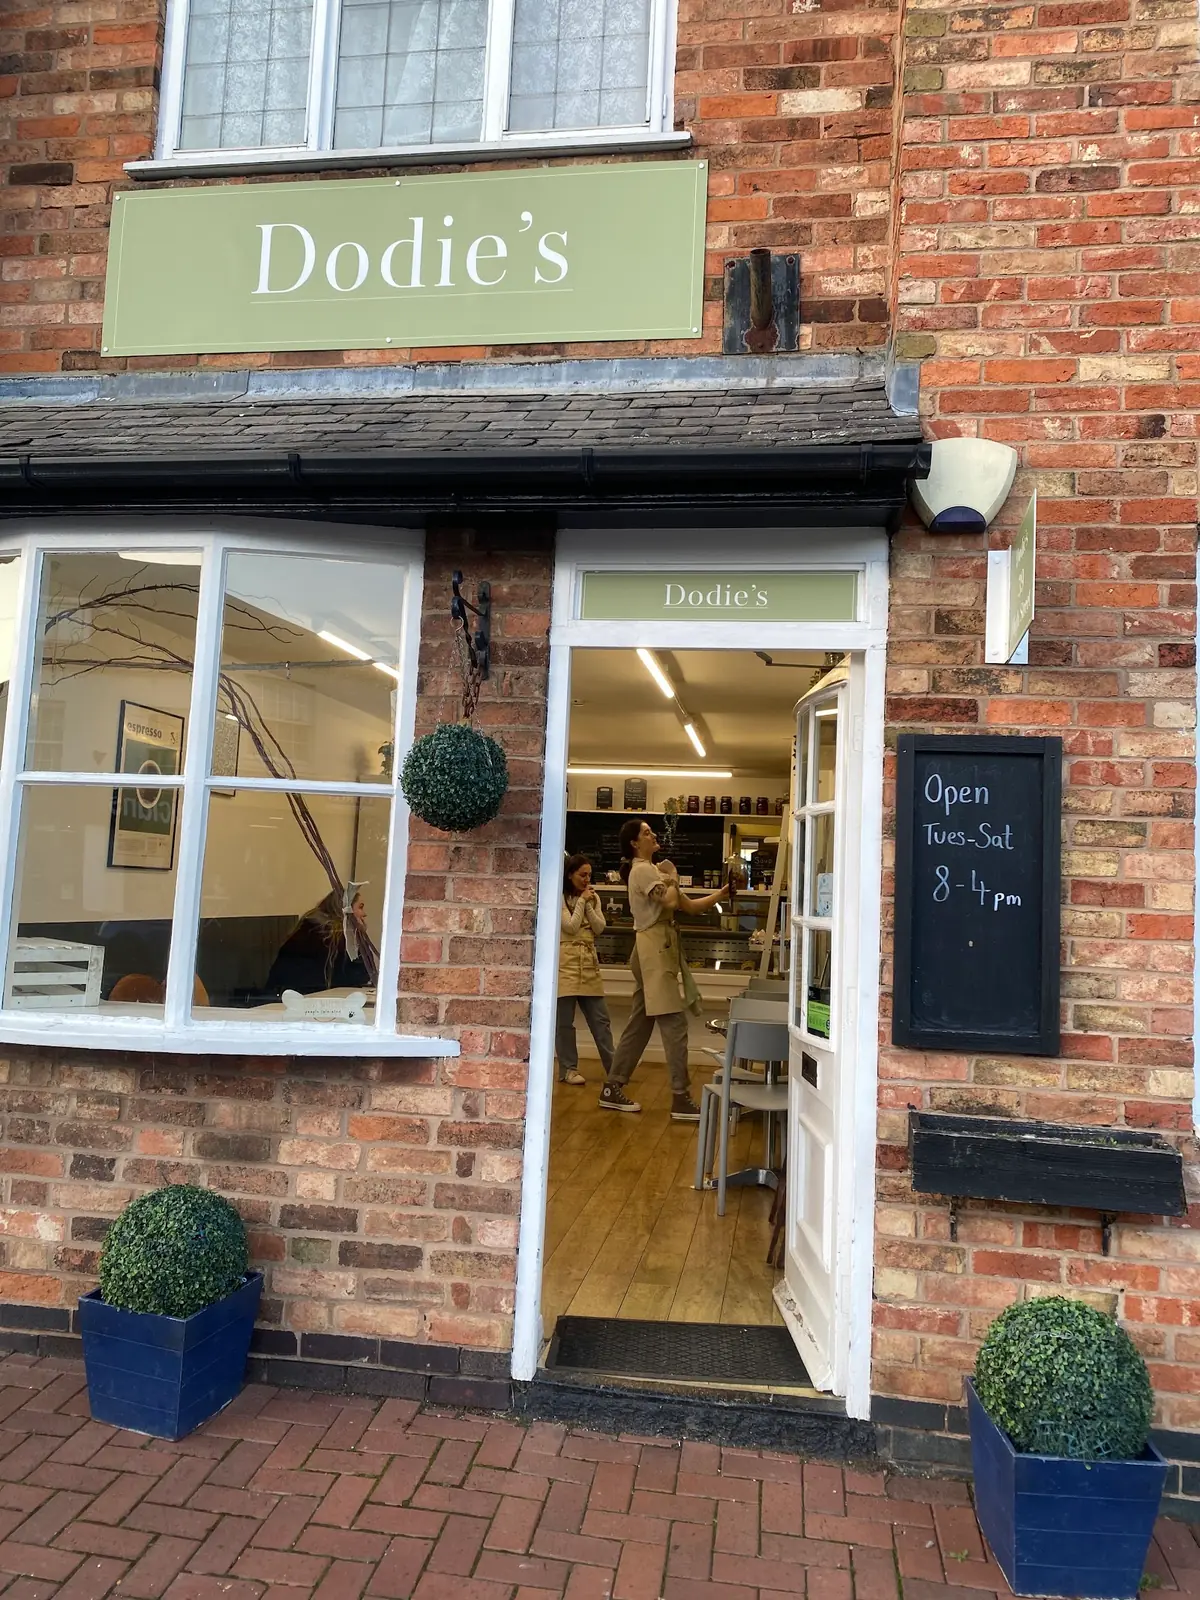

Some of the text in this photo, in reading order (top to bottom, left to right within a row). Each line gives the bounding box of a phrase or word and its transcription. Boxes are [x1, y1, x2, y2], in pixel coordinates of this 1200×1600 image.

[251, 210, 569, 294] Dodie's
[663, 583, 768, 606] Dodie's
[127, 722, 162, 739] espresso
[924, 773, 989, 816] Open
[922, 822, 1014, 851] Tues-Sat
